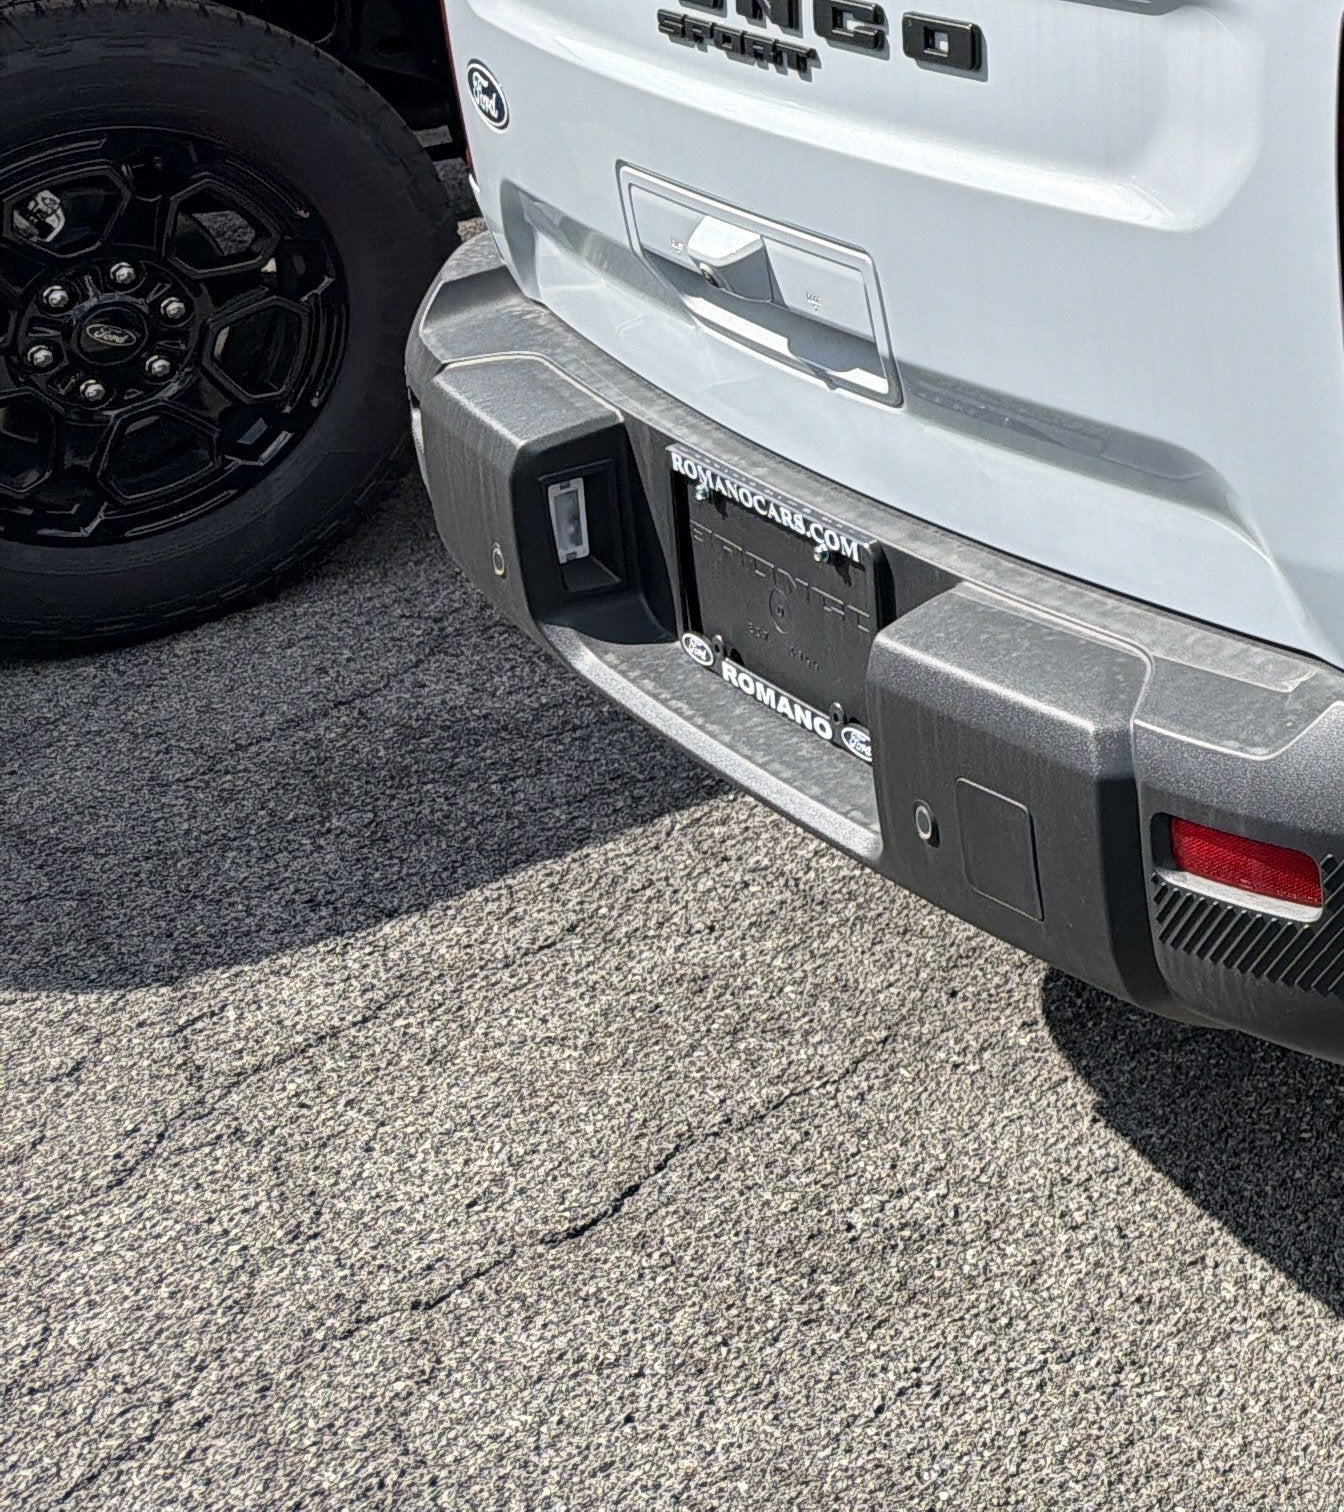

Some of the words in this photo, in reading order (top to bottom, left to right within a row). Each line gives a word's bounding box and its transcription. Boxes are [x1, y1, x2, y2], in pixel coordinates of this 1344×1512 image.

[656, 8, 818, 74] SPORT
[470, 68, 502, 122] Ford
[91, 326, 131, 344] Ford
[670, 451, 862, 564] ROMANOCARS.COM
[687, 636, 709, 662] Ford
[721, 660, 834, 742] ROMANO
